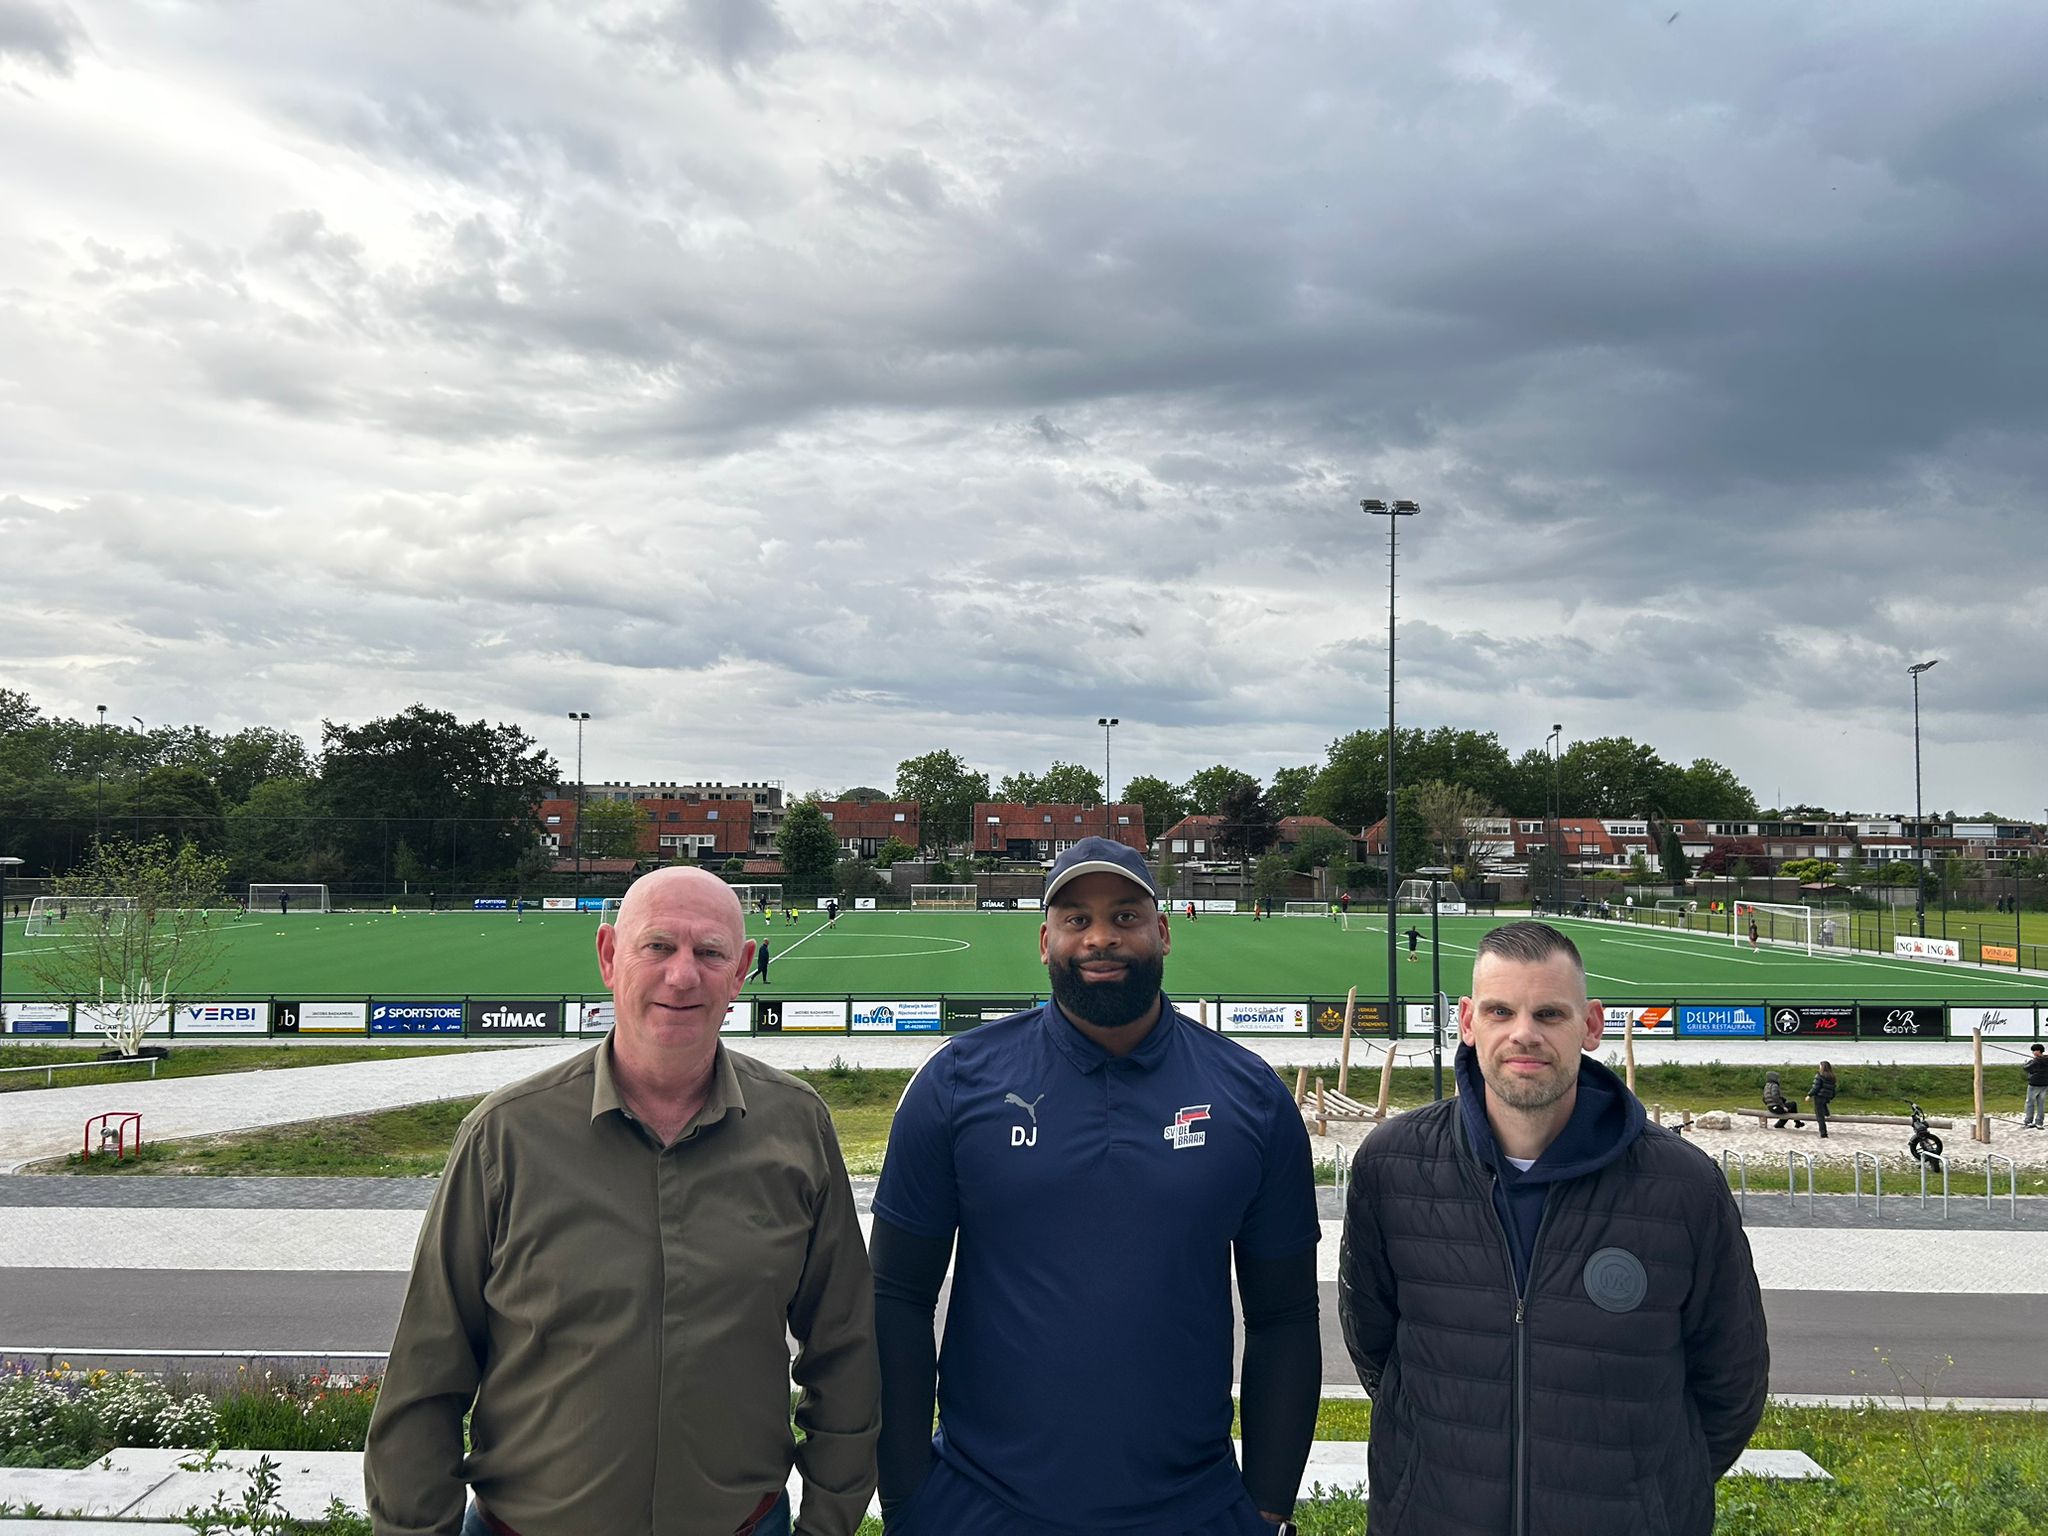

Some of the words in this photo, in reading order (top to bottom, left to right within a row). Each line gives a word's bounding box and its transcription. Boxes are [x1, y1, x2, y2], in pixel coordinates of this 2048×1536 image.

[1896, 942, 1912, 952] ING
[1927, 944, 1944, 955] ING
[189, 1008, 256, 1021] VERBI
[388, 1008, 461, 1018] SPORTSTORE
[1233, 1014, 1284, 1023] MOSMAN
[1686, 1011, 1731, 1024] DELPHI
[1011, 1125, 1038, 1147] DJ
[1164, 1127, 1176, 1139] SV
[1178, 1125, 1188, 1136] DE
[1178, 1131, 1204, 1146] BRAAK
